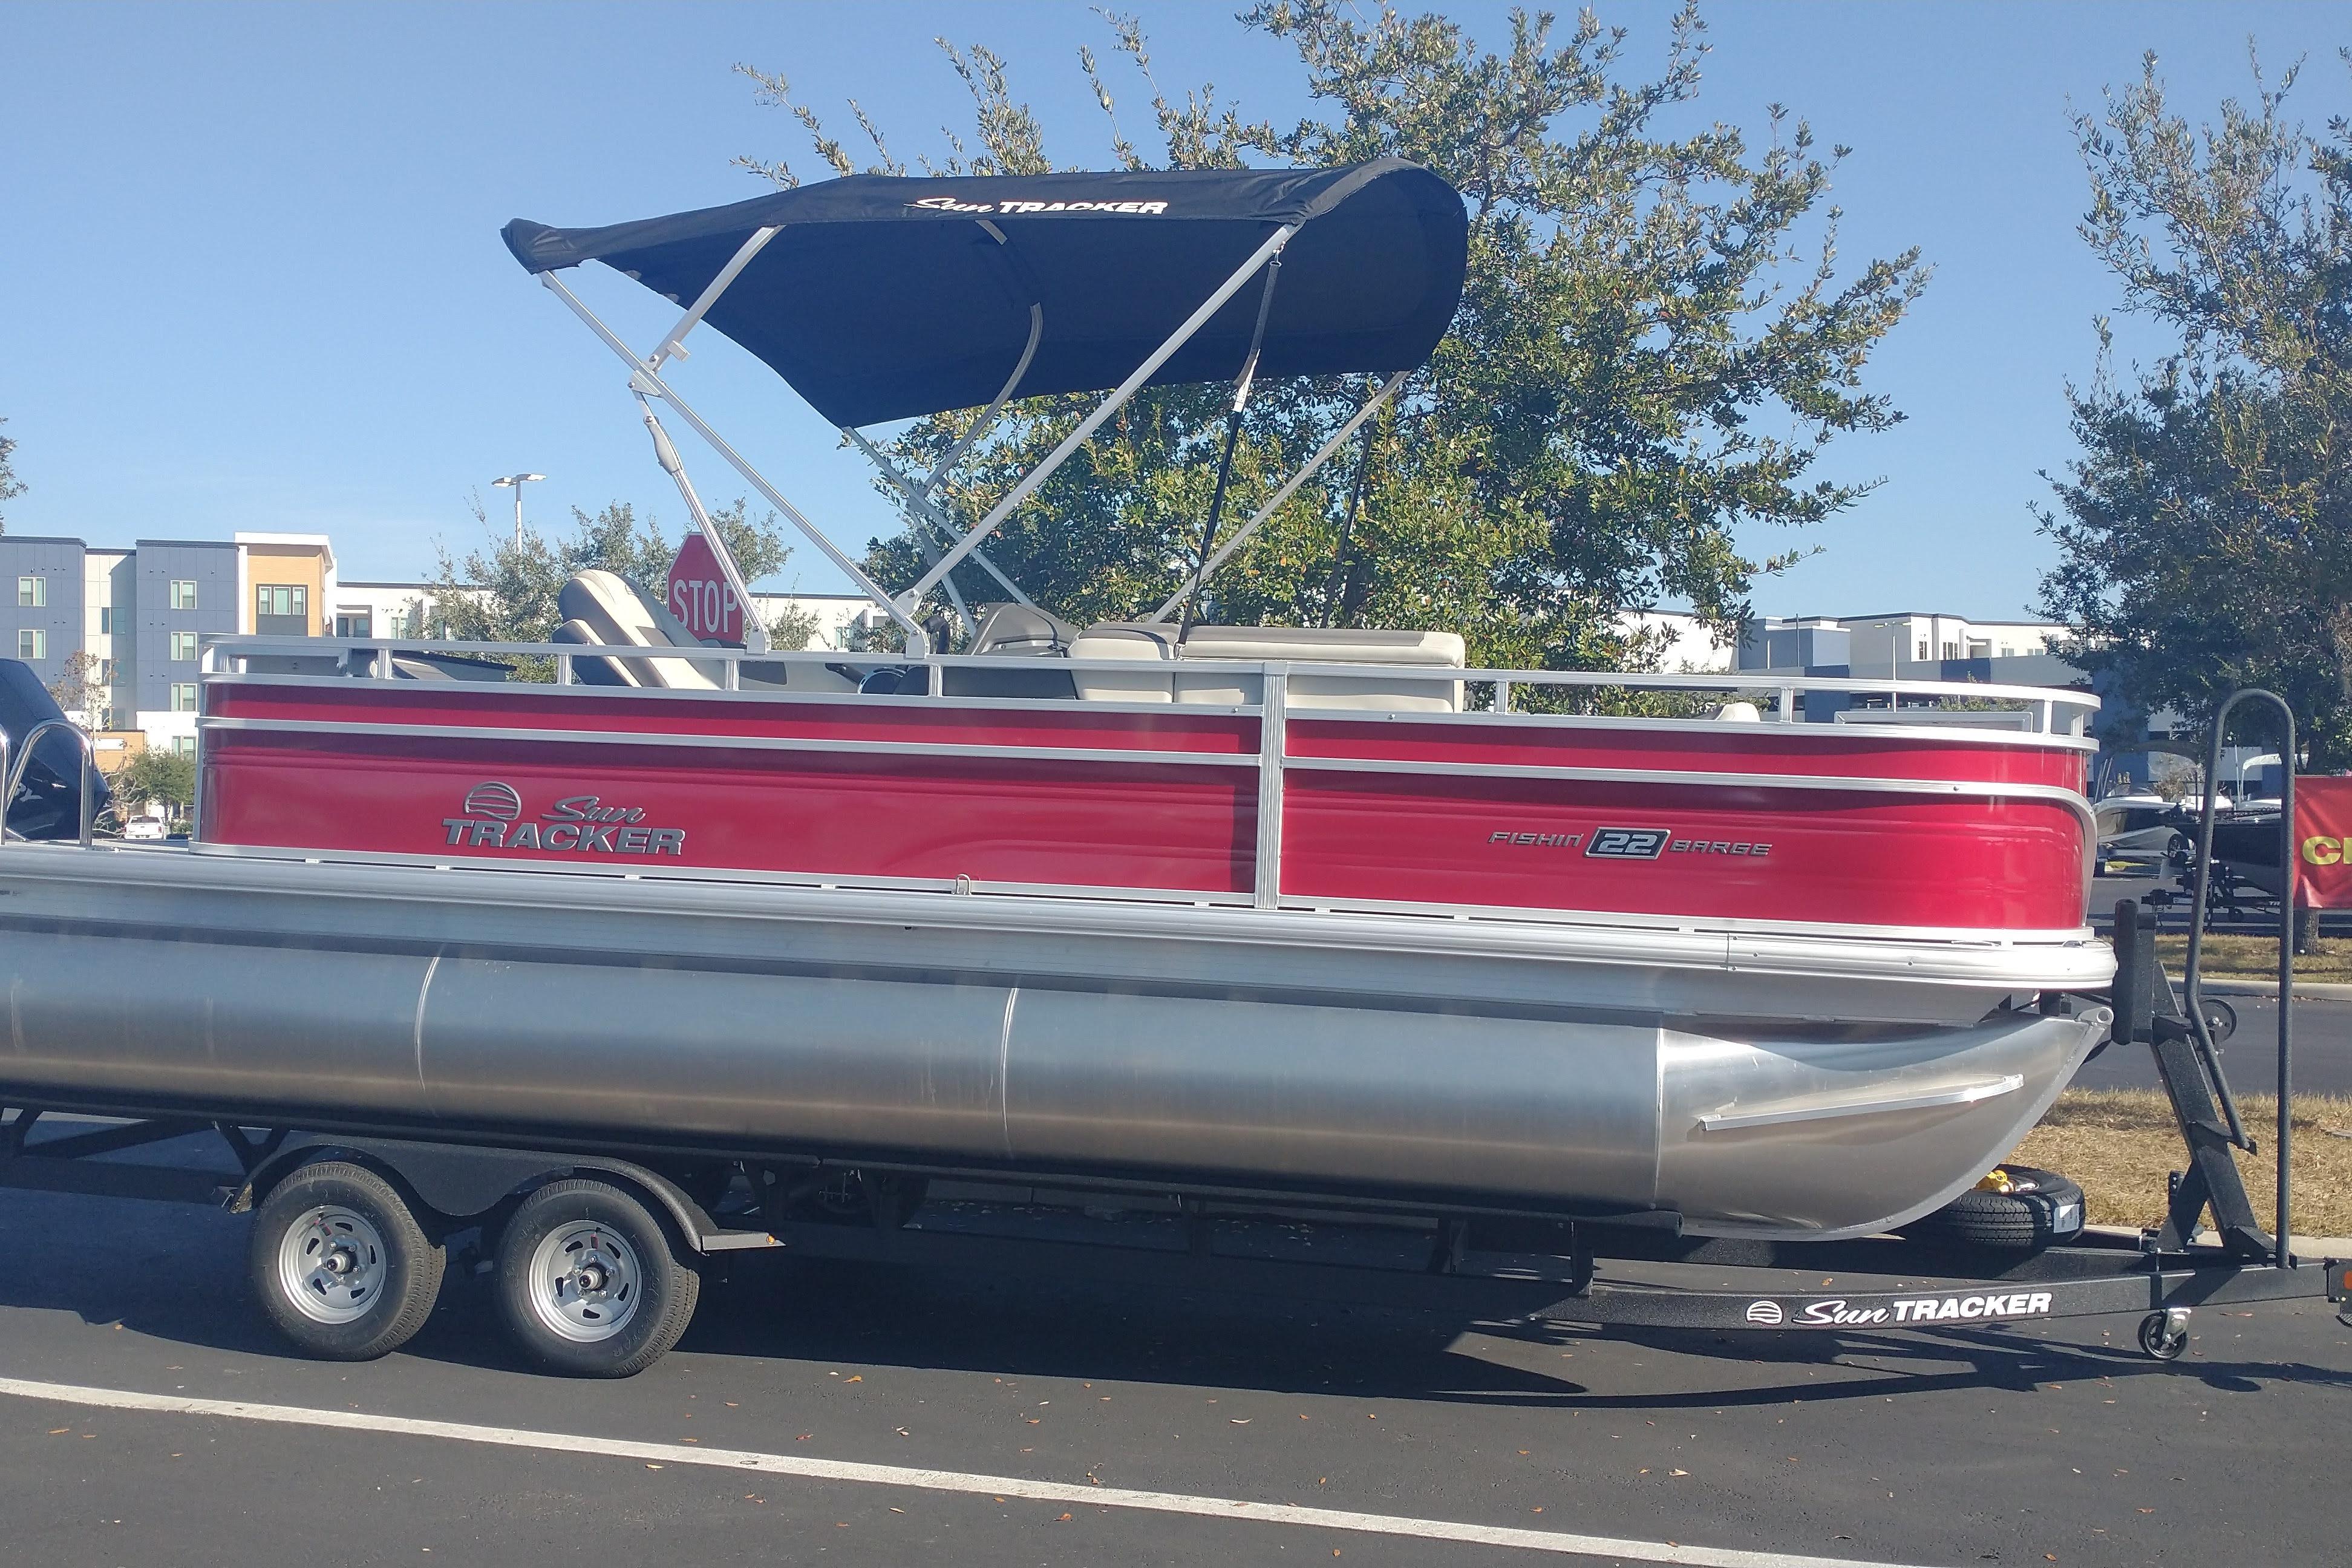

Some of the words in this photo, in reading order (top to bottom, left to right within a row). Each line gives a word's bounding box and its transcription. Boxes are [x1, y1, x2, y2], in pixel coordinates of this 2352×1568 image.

[903, 197, 995, 213] Sun
[999, 201, 1169, 215] TRACKER
[673, 579, 739, 633] STOP
[541, 795, 646, 824] Sun
[442, 818, 685, 855] TRACKER
[1597, 832, 1659, 854] 22
[1669, 840, 1773, 856] BARGE
[1791, 1300, 1890, 1324] Sun
[1892, 1292, 2053, 1322] TRACKER
